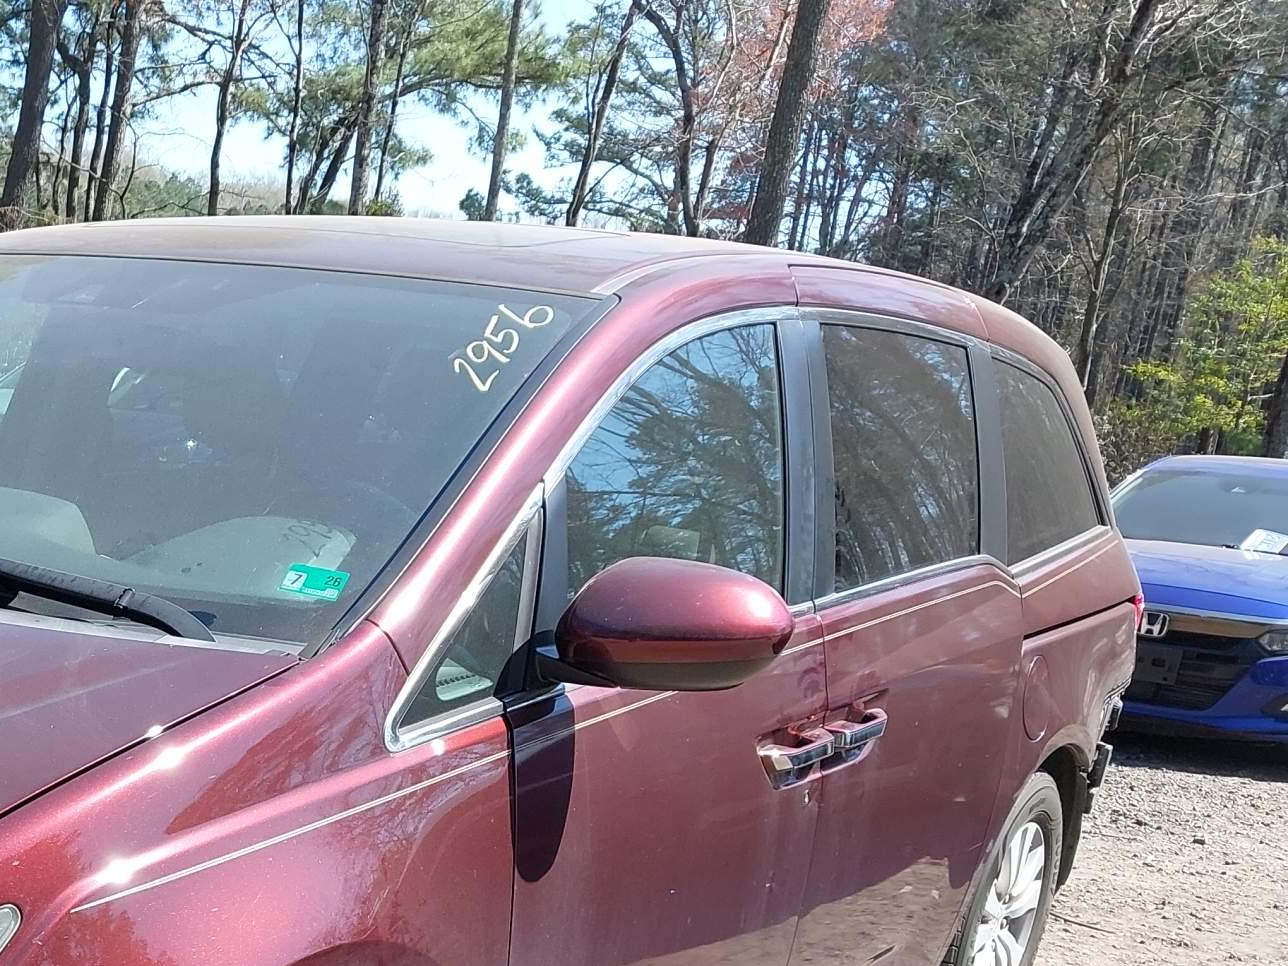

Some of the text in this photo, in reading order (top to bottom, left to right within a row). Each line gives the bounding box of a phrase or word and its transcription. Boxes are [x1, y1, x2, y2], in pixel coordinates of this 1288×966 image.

[454, 304, 554, 391] 2956
[290, 573, 342, 587] 7 26
